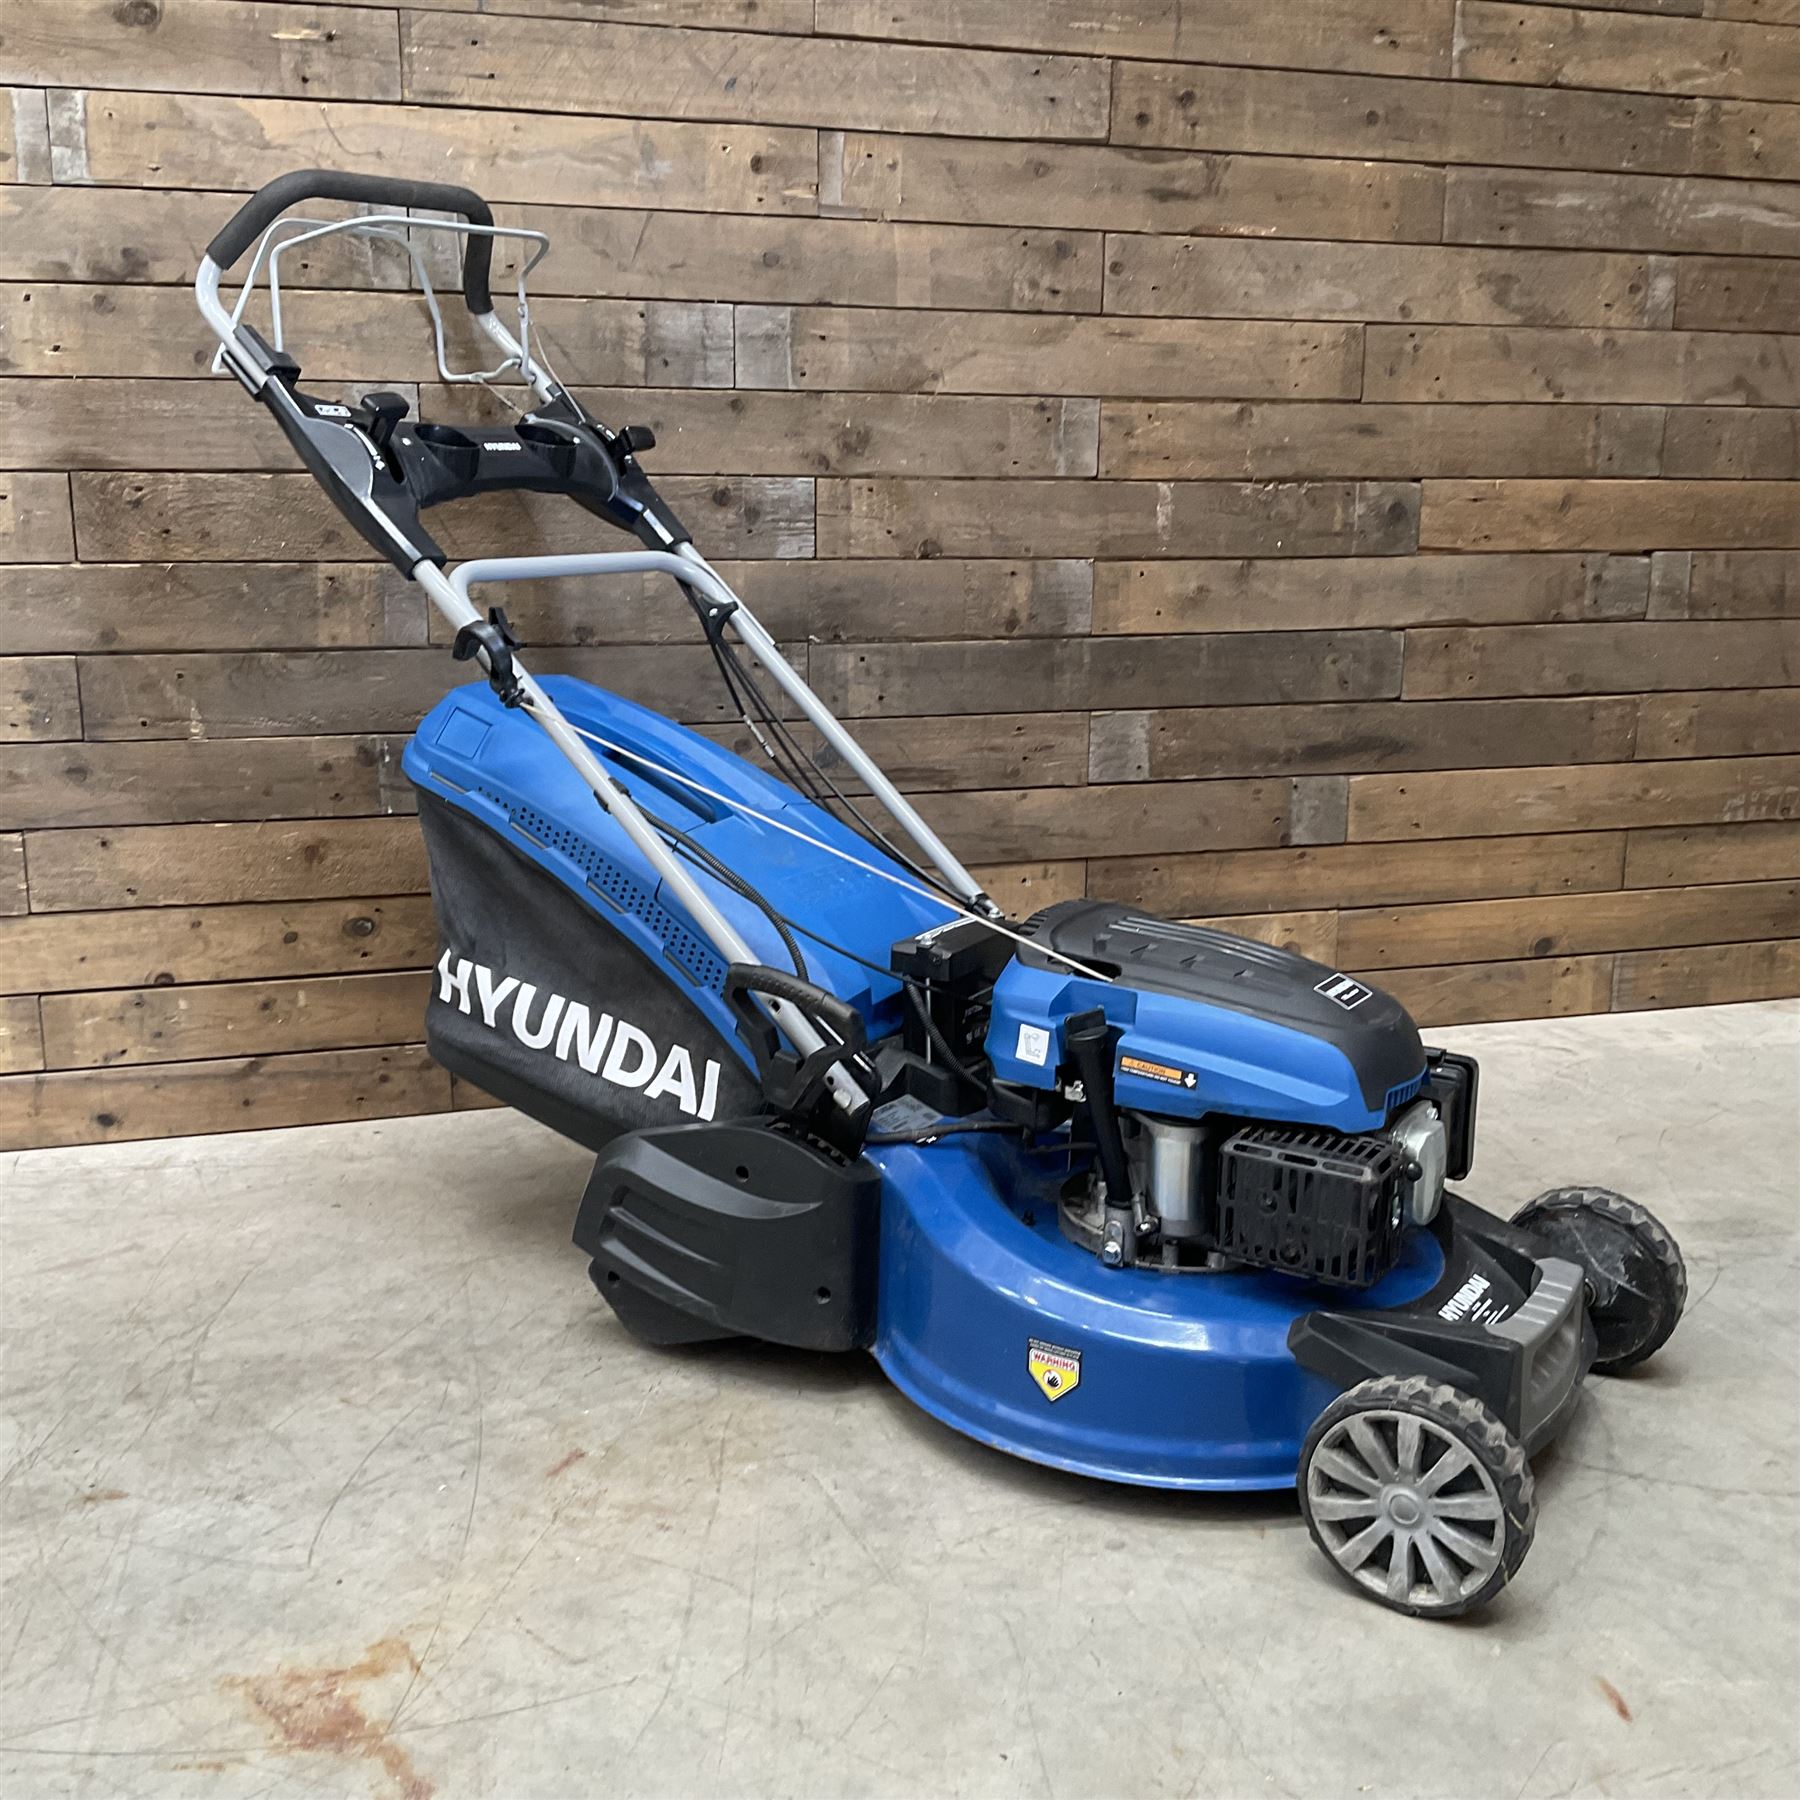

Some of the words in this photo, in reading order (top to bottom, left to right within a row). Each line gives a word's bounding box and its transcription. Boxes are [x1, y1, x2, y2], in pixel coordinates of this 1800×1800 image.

[438, 948, 721, 1122] HYUNDAI
[1438, 1273, 1490, 1321] HYUNDAI
[1034, 1351, 1075, 1371] WARNING
